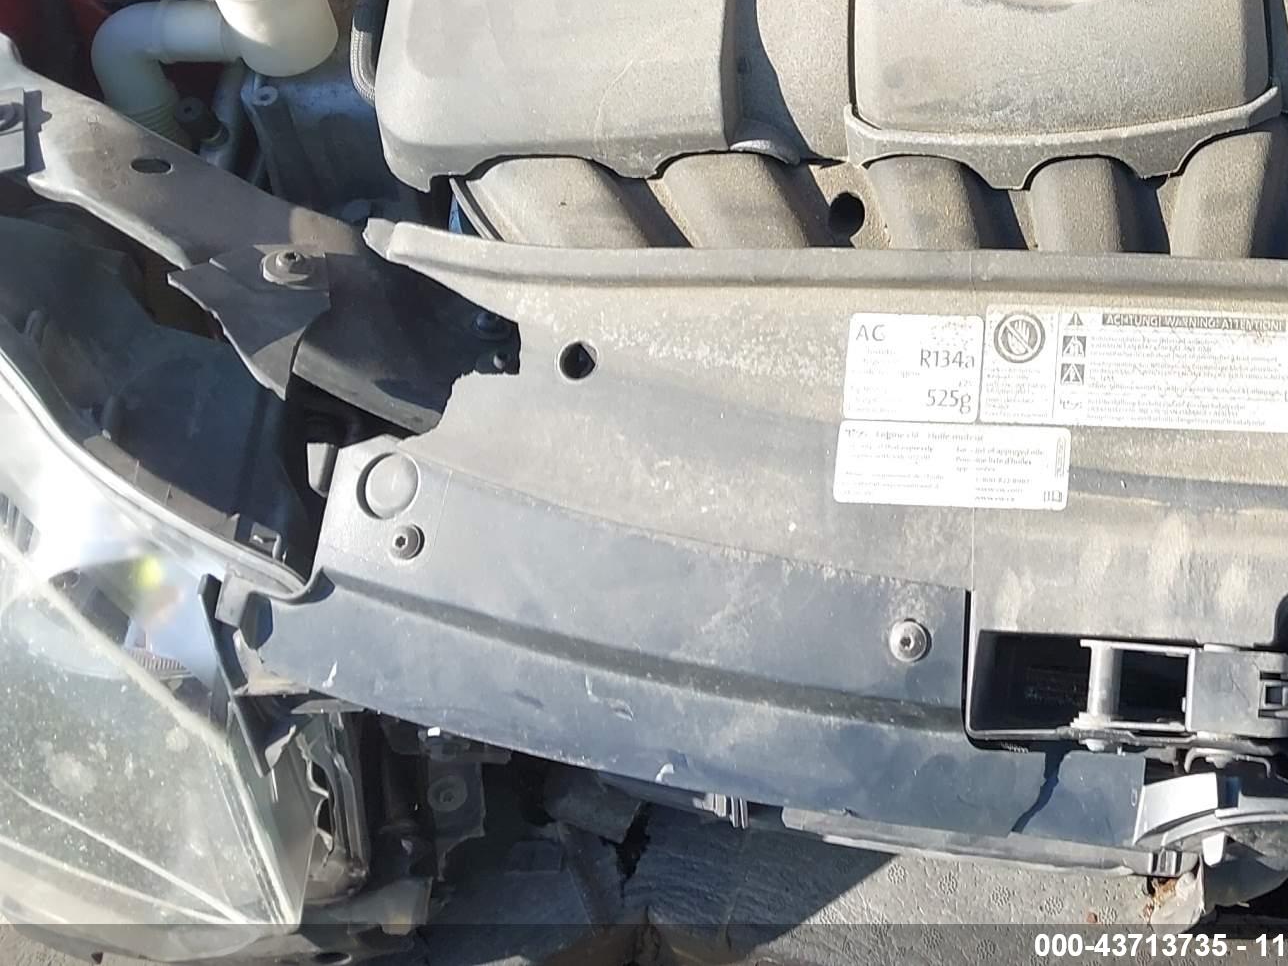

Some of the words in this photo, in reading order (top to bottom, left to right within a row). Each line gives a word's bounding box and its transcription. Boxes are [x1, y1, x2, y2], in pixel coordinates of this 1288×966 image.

[855, 324, 886, 342] AC
[920, 348, 975, 369] R134a
[926, 388, 972, 415] 525g
